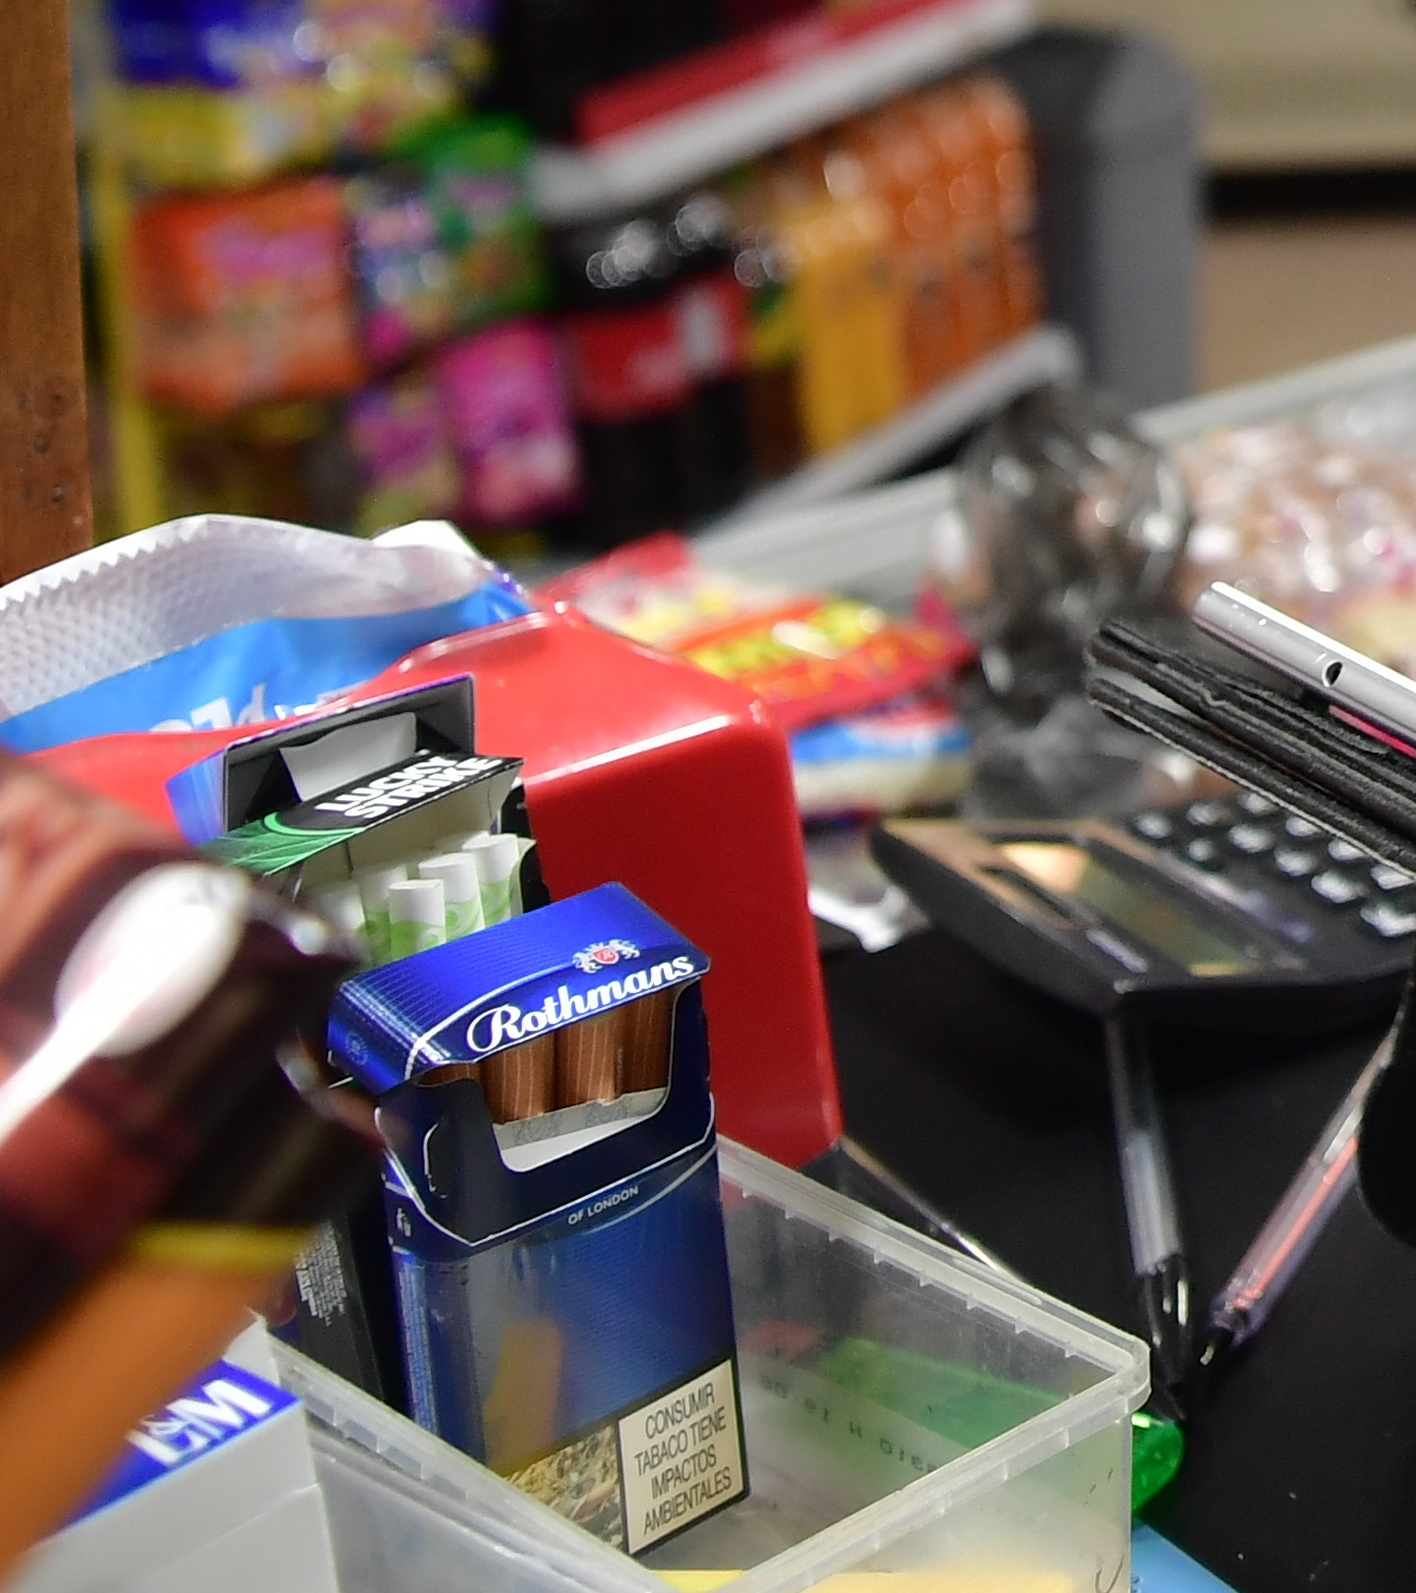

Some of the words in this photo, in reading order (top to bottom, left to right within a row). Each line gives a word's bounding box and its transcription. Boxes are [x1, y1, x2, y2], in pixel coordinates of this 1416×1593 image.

[315, 756, 457, 812] LUCKY
[344, 757, 503, 819] STRIKE
[466, 955, 695, 1053] Rothmans
[567, 1208, 585, 1225] OF
[587, 1185, 639, 1217] LONDON
[645, 1382, 715, 1439] CONSUMIR
[634, 1429, 688, 1476] TABACO
[689, 1406, 728, 1447] TIENE
[643, 1466, 733, 1536] AMBIENTALES
[651, 1444, 717, 1500] IMPACTOS
